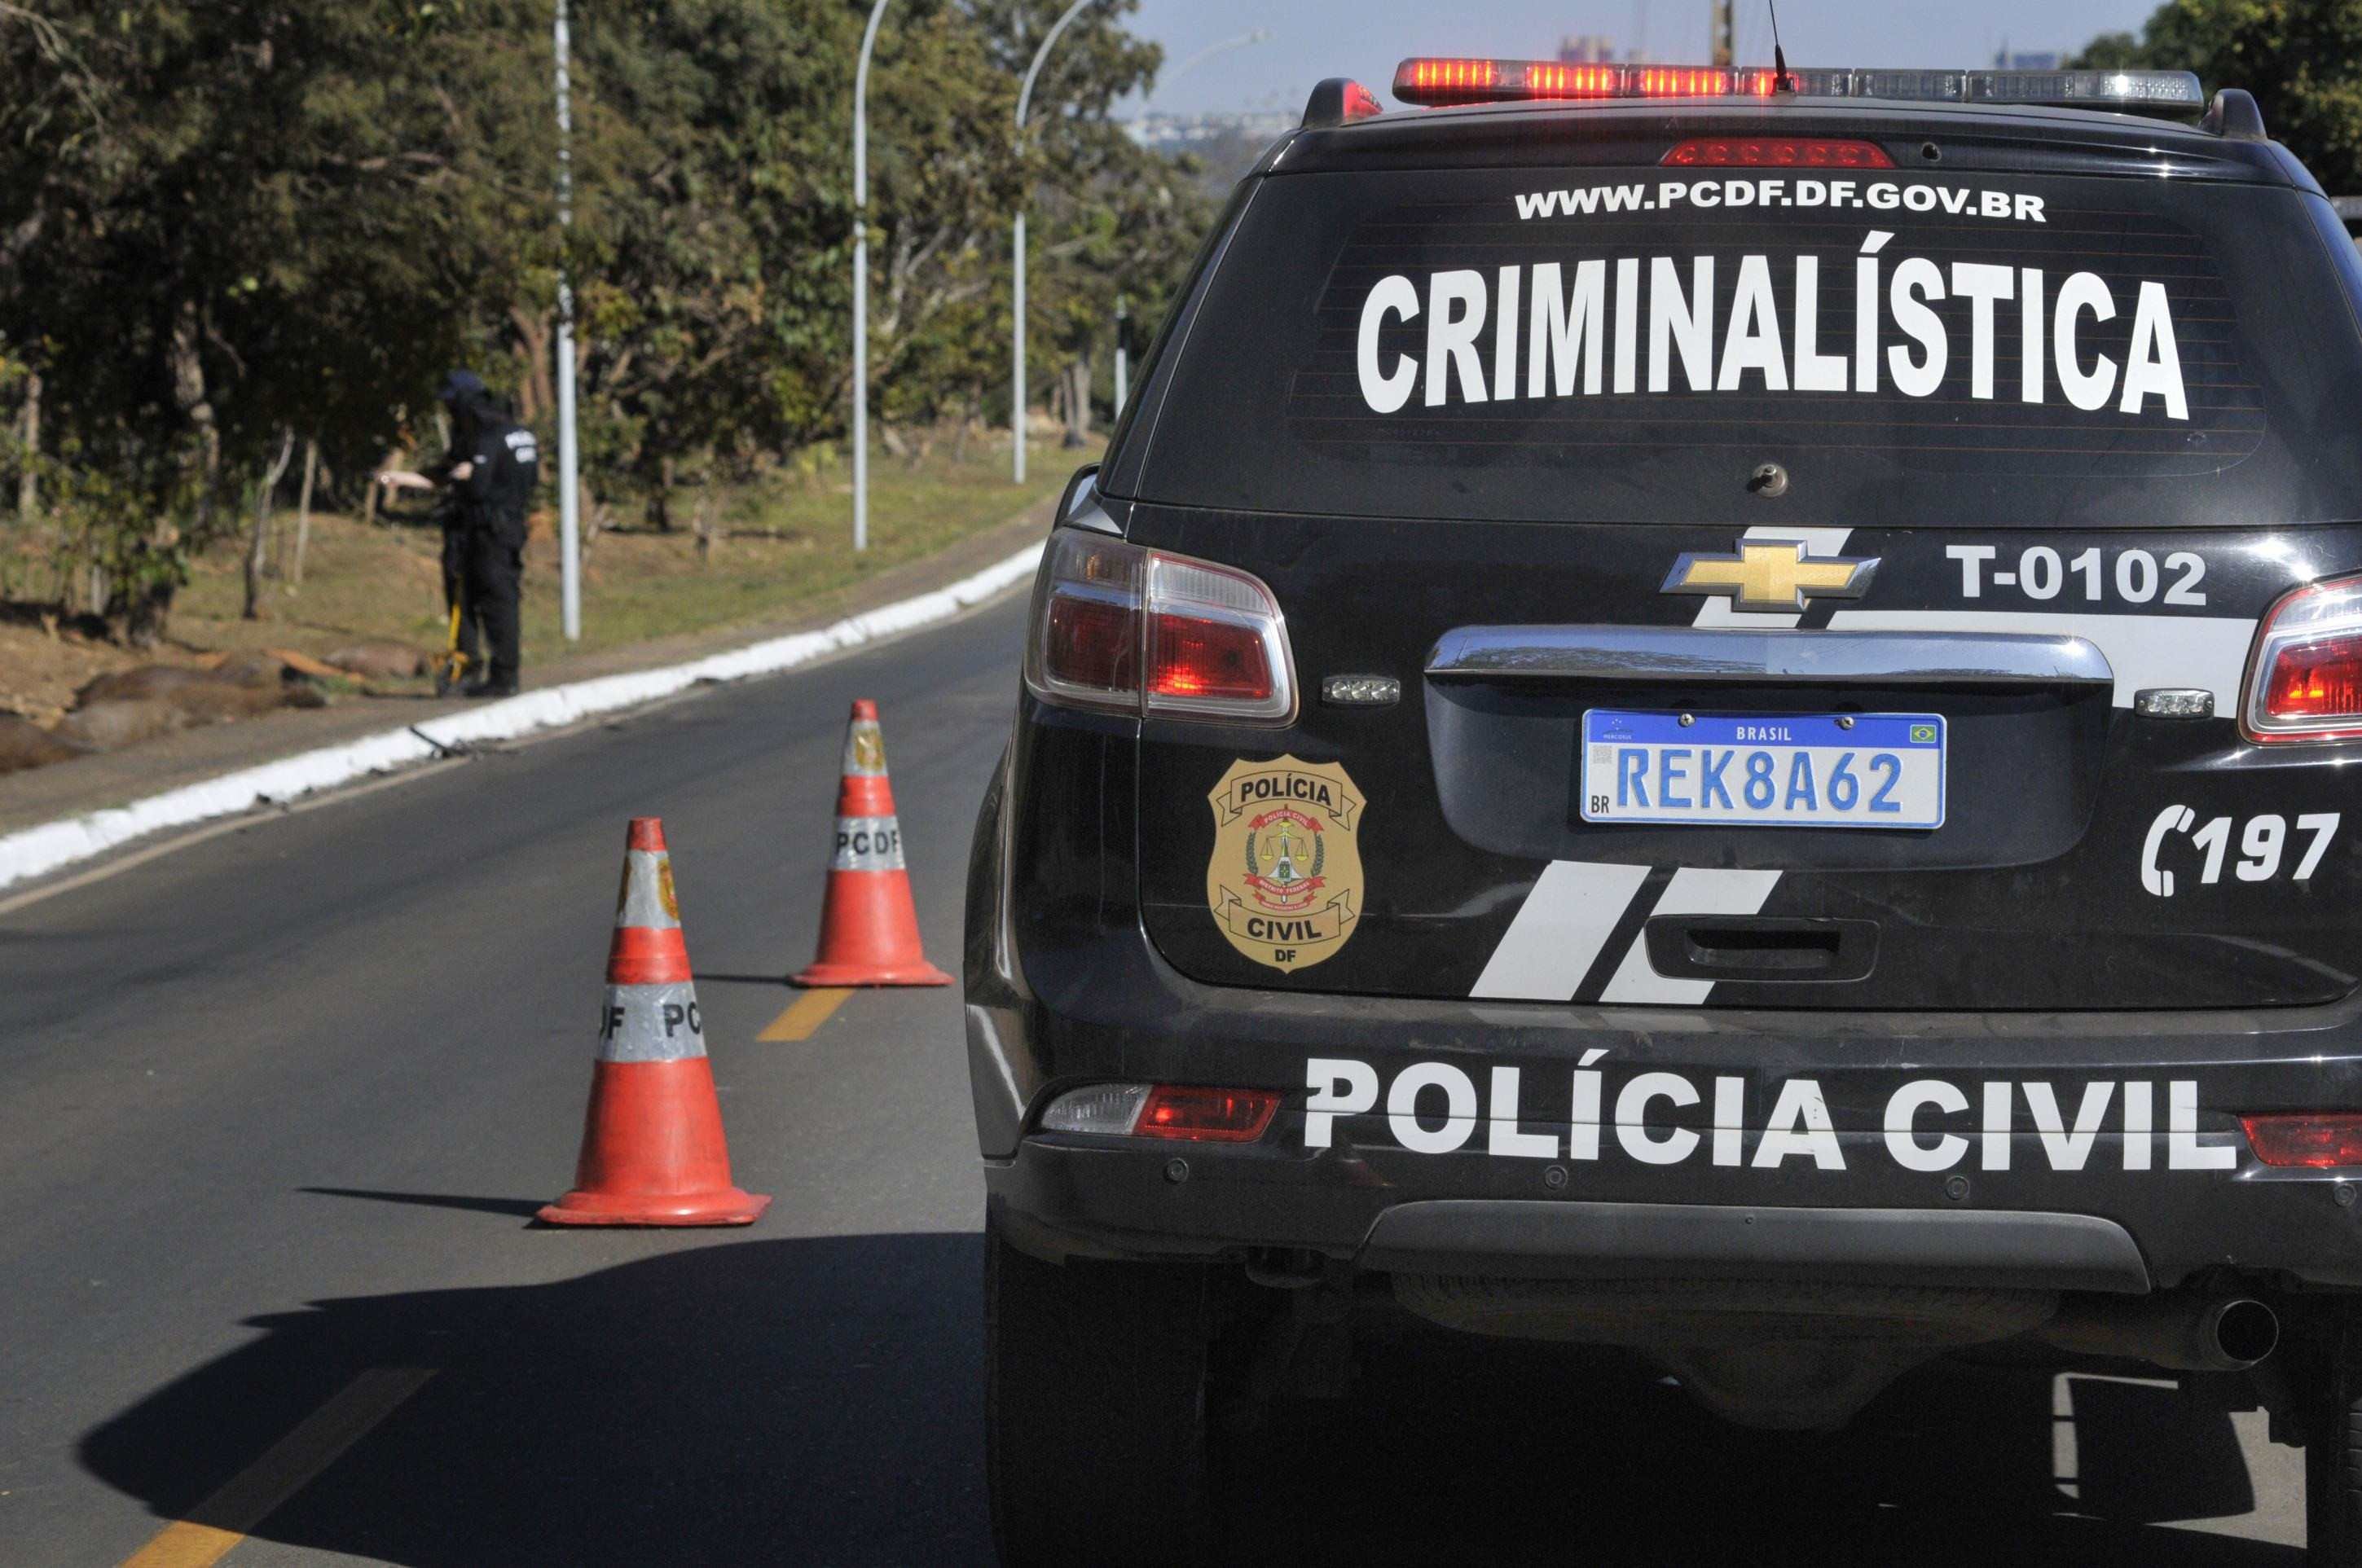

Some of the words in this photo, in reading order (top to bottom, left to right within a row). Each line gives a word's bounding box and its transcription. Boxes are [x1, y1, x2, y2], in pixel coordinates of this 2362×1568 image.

[1515, 179, 2047, 222] WWW.PCDF.DF.GOV.BR
[1357, 230, 2190, 422] CRIMINALÍSTICA
[1946, 545, 2207, 606] T-0102
[1735, 726, 1792, 741] BRASIL
[1240, 772, 1332, 806] POLÍCIA
[1617, 748, 1903, 812] REK8A62
[1590, 795, 1610, 814] BR
[2192, 812, 2341, 884] 197
[1247, 917, 1322, 941] CIVIL
[1274, 949, 1296, 963] DF
[1304, 1048, 1847, 1171] POLÍCIA
[1883, 1079, 2237, 1172] CIVIL
